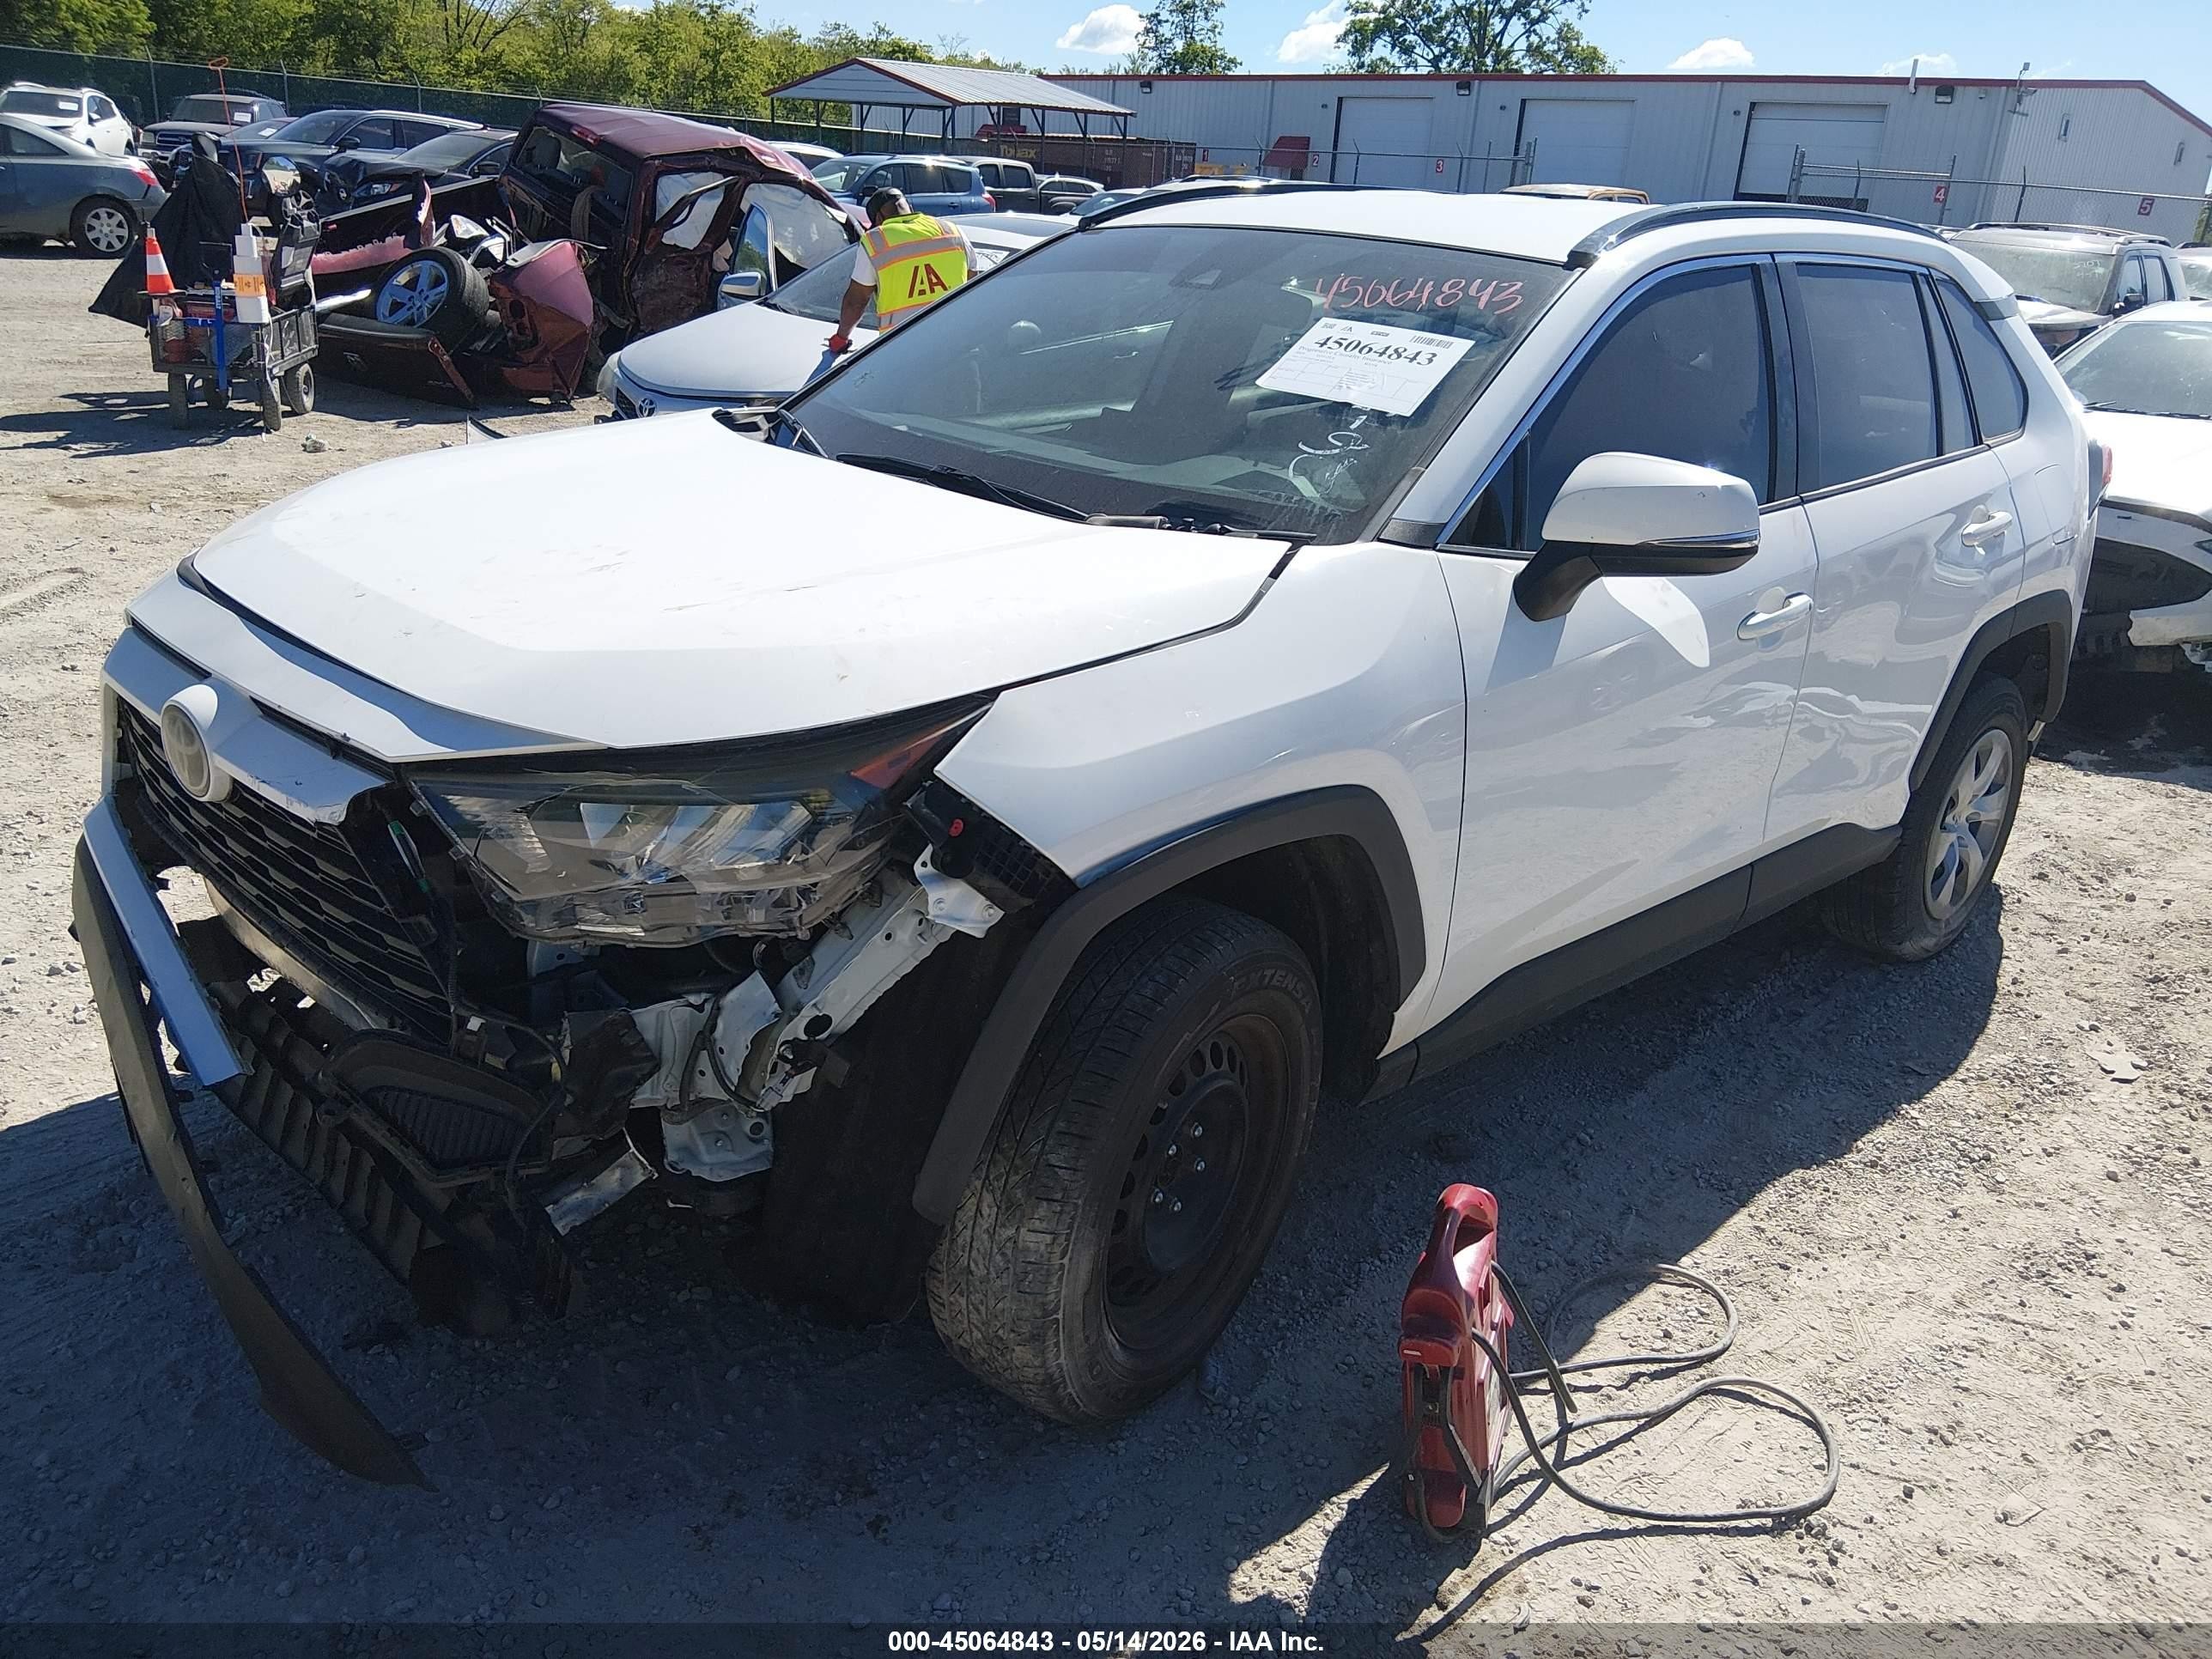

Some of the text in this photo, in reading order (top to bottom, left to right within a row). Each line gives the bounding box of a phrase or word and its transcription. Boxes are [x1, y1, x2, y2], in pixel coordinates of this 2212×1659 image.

[1313, 155, 1320, 167] 2
[1436, 159, 1443, 173] 3
[1935, 190, 1945, 200] 4
[2141, 199, 2152, 214] 5
[1315, 276, 1526, 315] 45064843
[1314, 335, 1438, 367] 45064843
